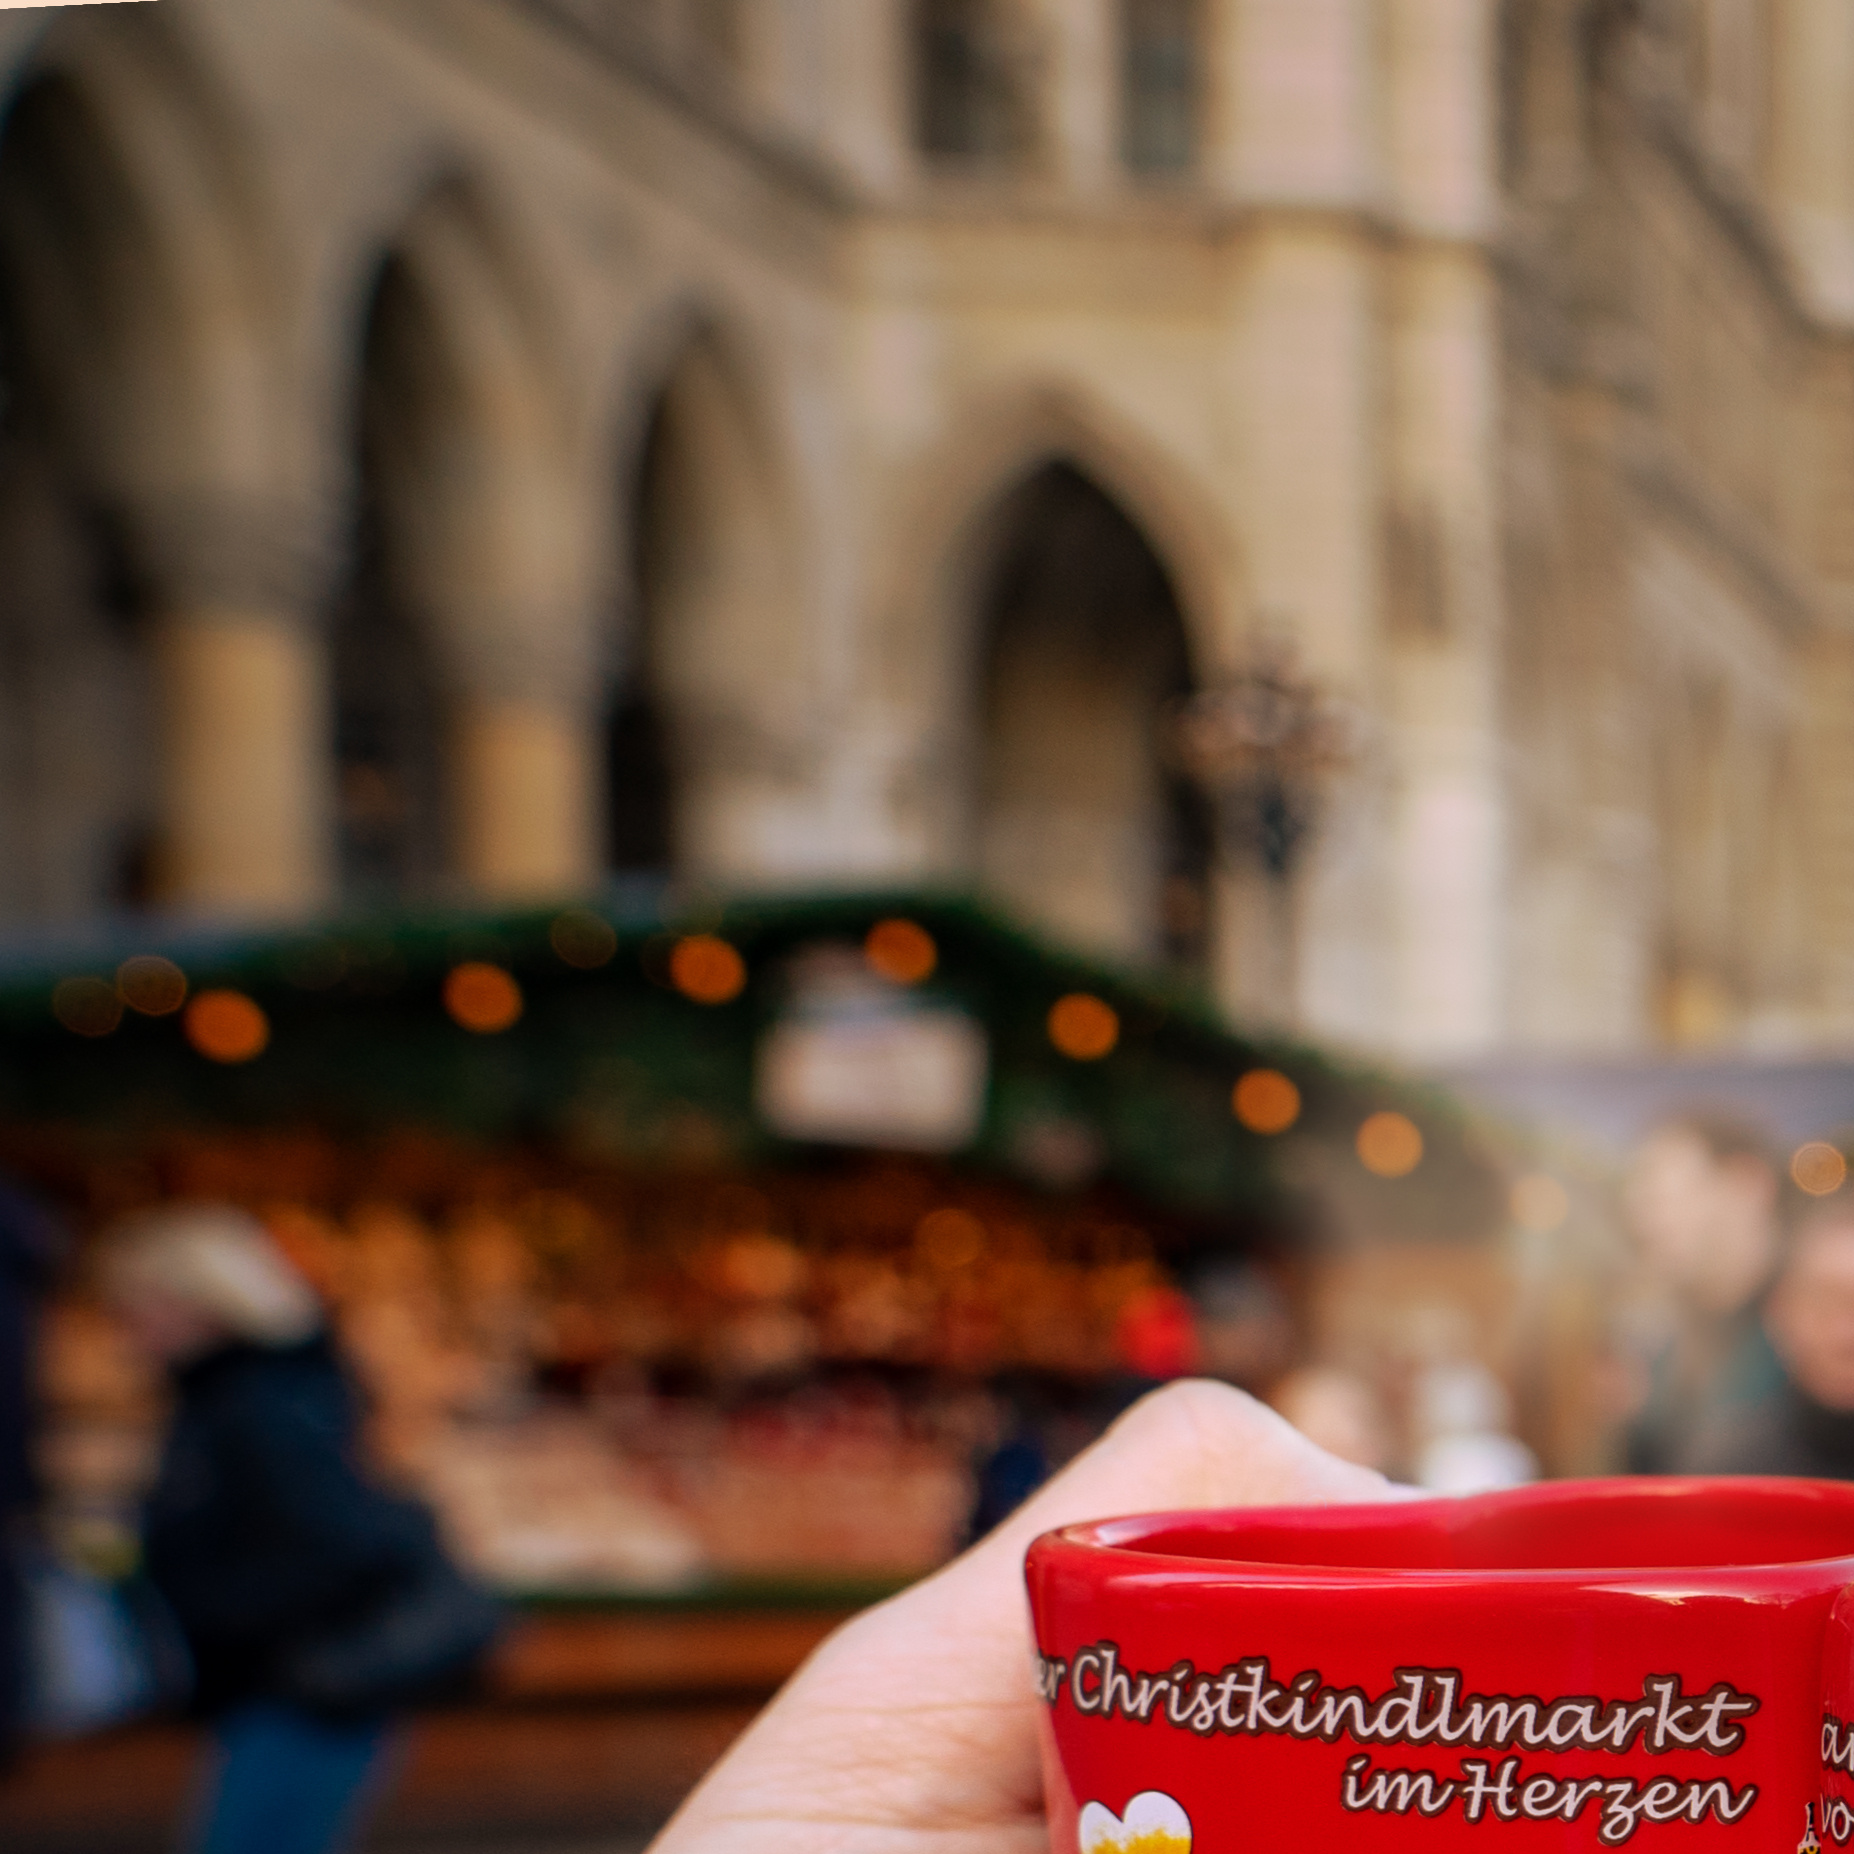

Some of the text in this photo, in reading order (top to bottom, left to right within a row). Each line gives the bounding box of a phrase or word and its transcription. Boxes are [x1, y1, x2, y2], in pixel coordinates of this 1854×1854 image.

[1074, 1649, 1752, 1748] Christkindlmarkt
[1343, 1760, 1754, 1839] im Herzen
